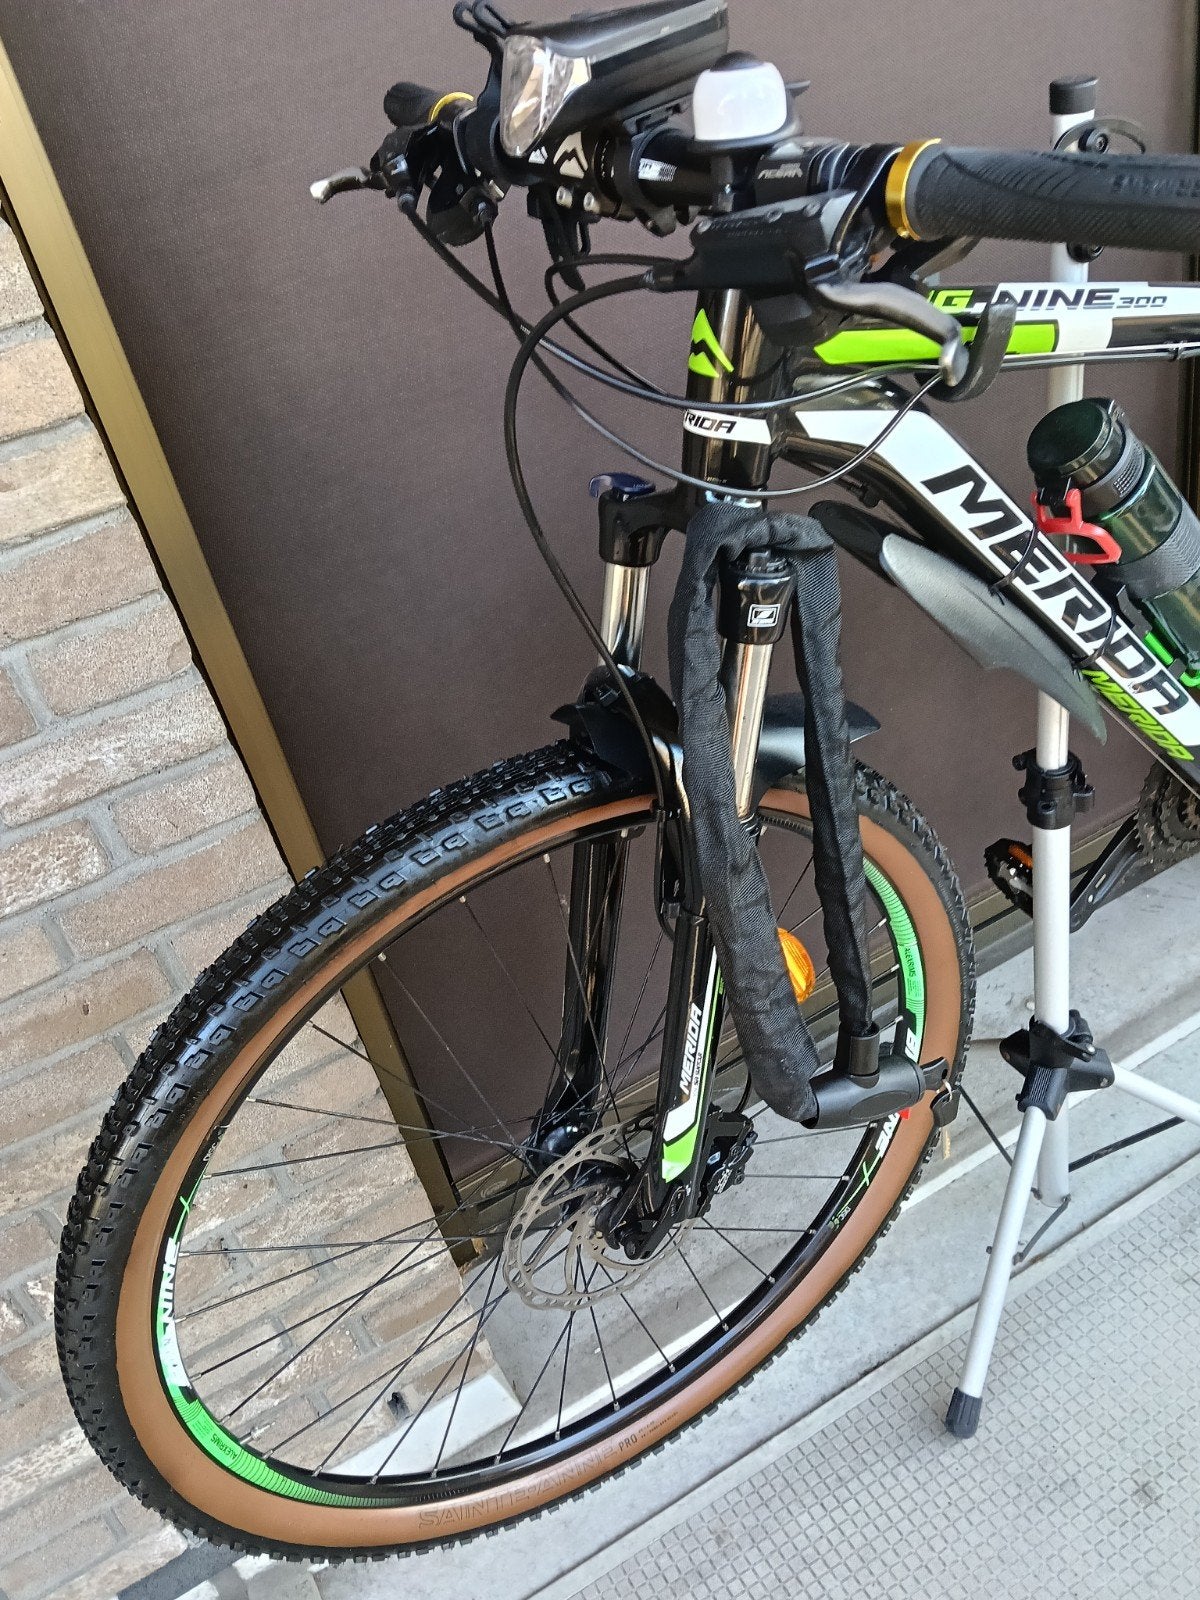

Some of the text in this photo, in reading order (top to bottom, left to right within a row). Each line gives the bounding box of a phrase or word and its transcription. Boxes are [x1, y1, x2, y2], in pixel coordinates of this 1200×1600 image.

[1116, 295, 1168, 308] 300
[920, 464, 1189, 716] MERIDA
[1081, 669, 1195, 762] MERIDA
[679, 1001, 703, 1096] MERIDA
[618, 1433, 638, 1453] PRO
